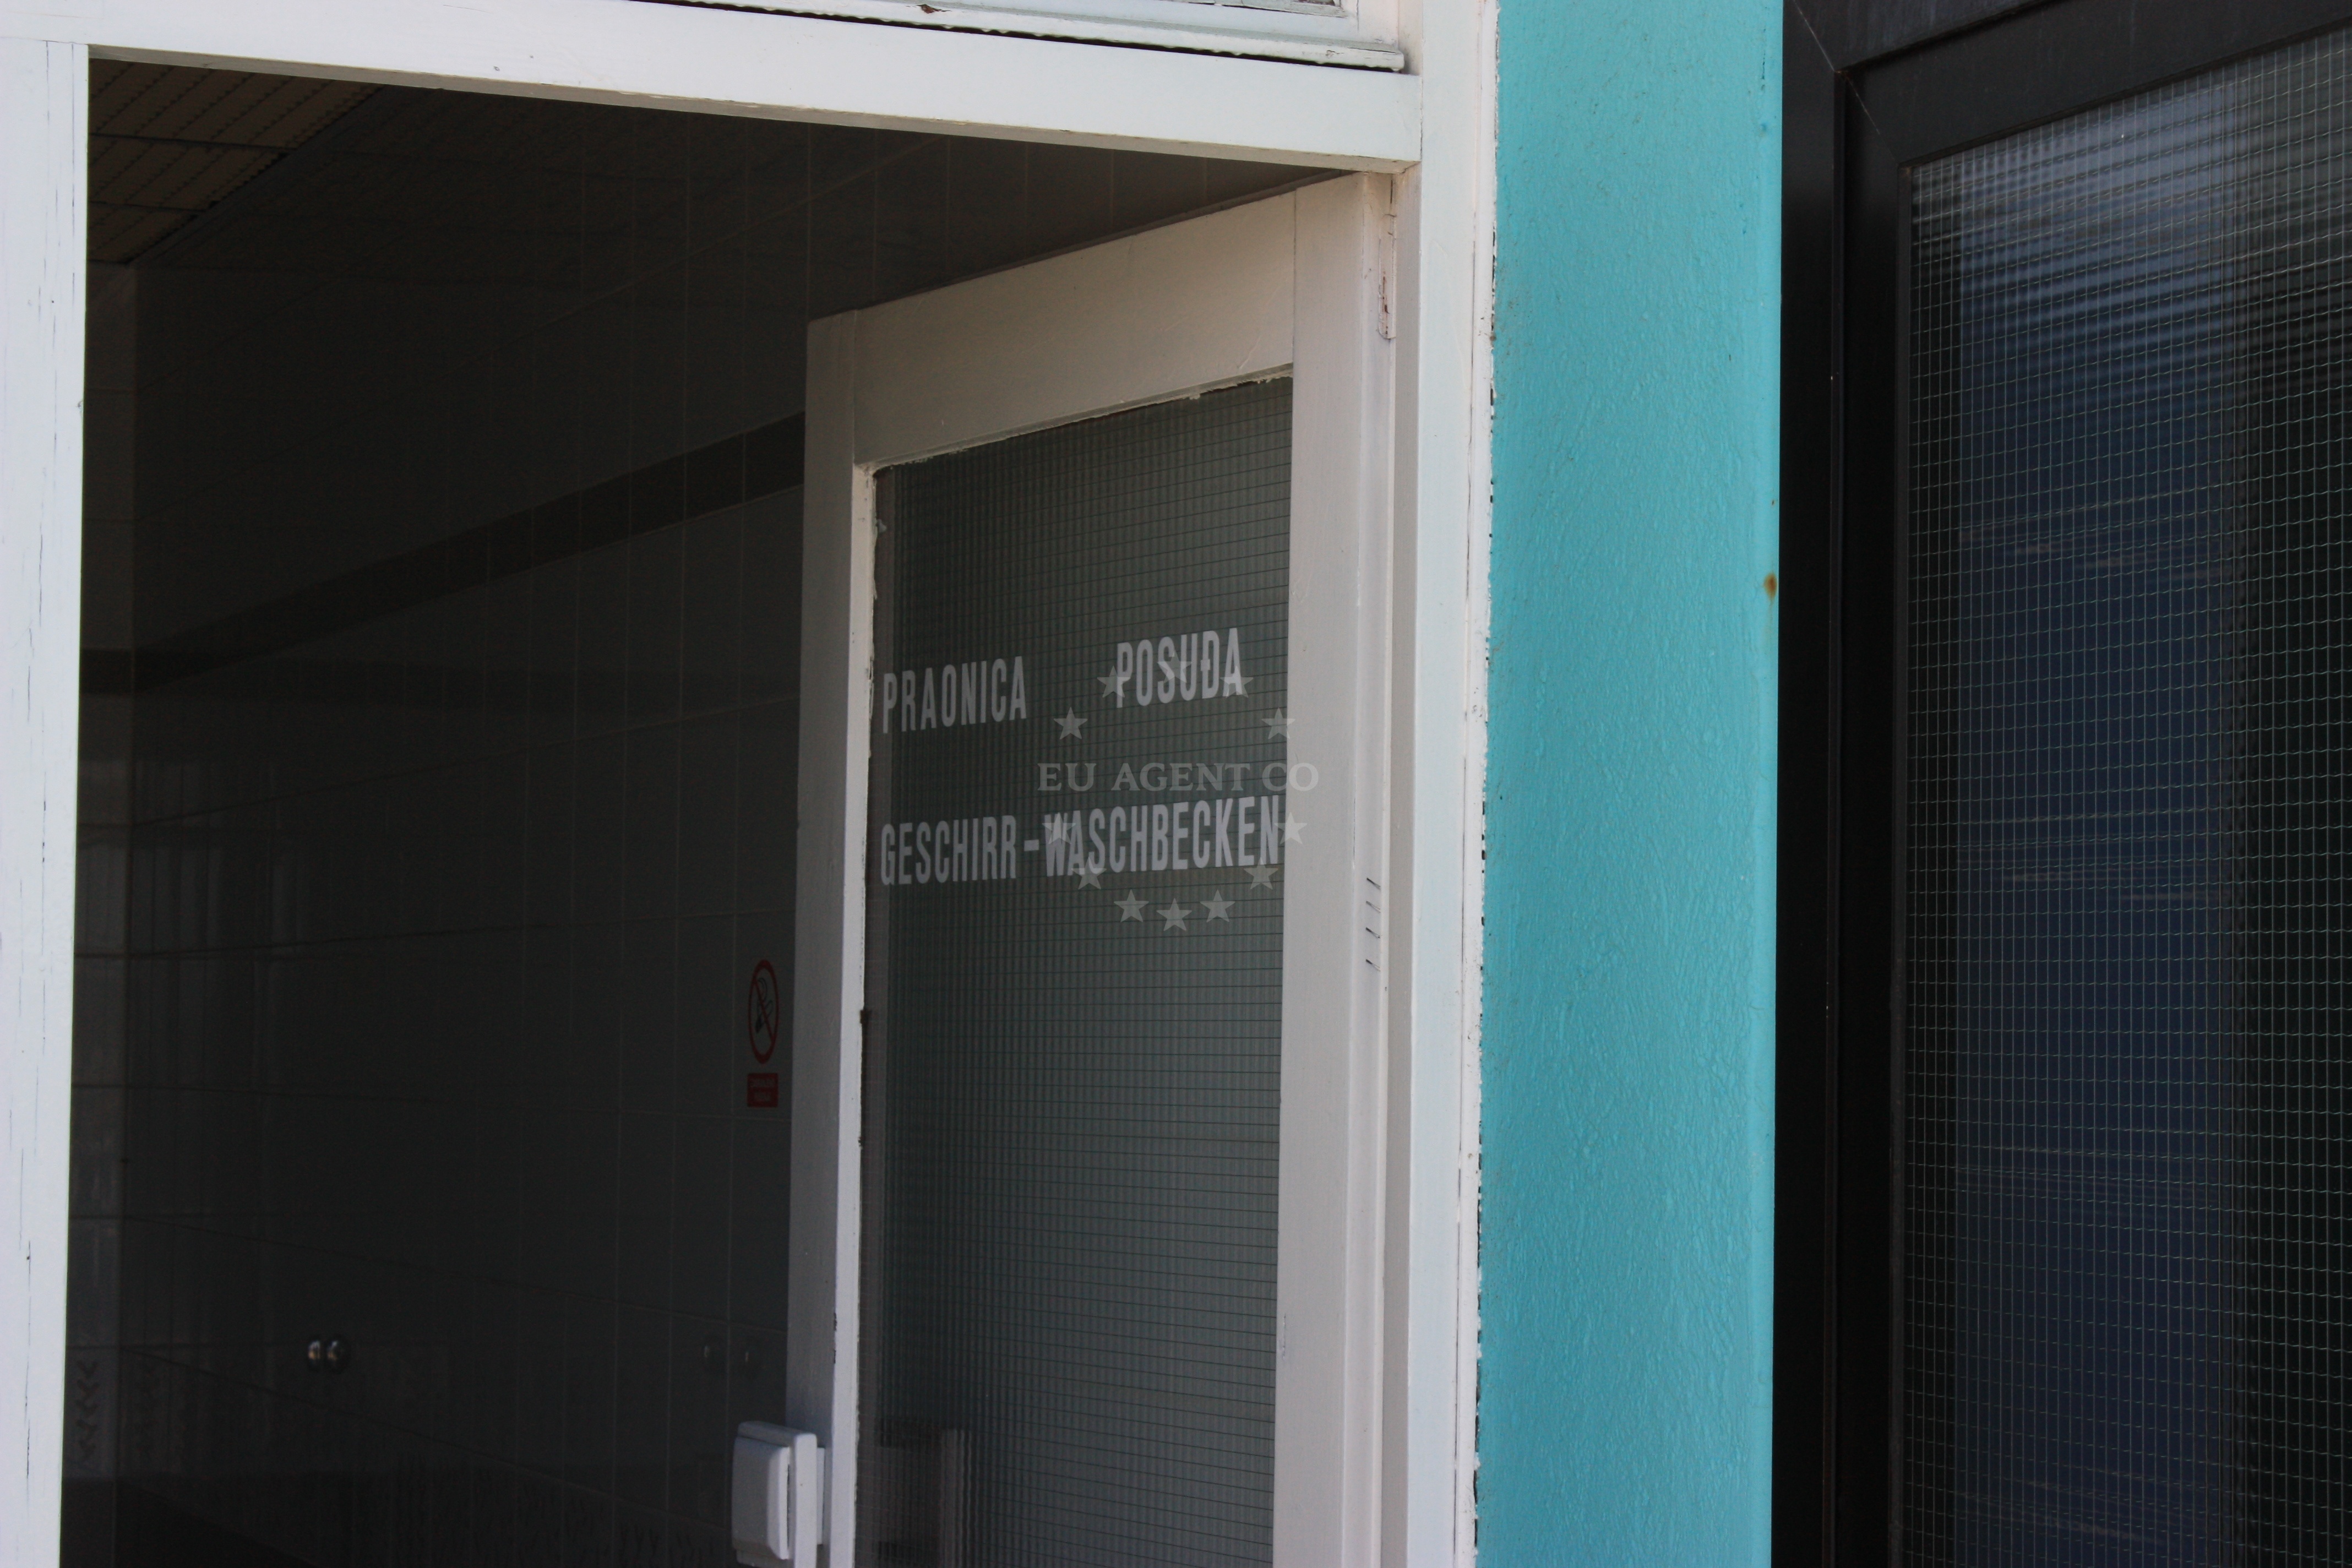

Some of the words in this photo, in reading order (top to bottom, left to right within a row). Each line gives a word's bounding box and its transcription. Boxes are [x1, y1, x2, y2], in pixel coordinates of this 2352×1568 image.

[883, 656, 1027, 734] PRAONICA
[1117, 628, 1243, 708] POSUĐA
[881, 795, 1280, 885] GESCHIRR-WASCHBECKEN
